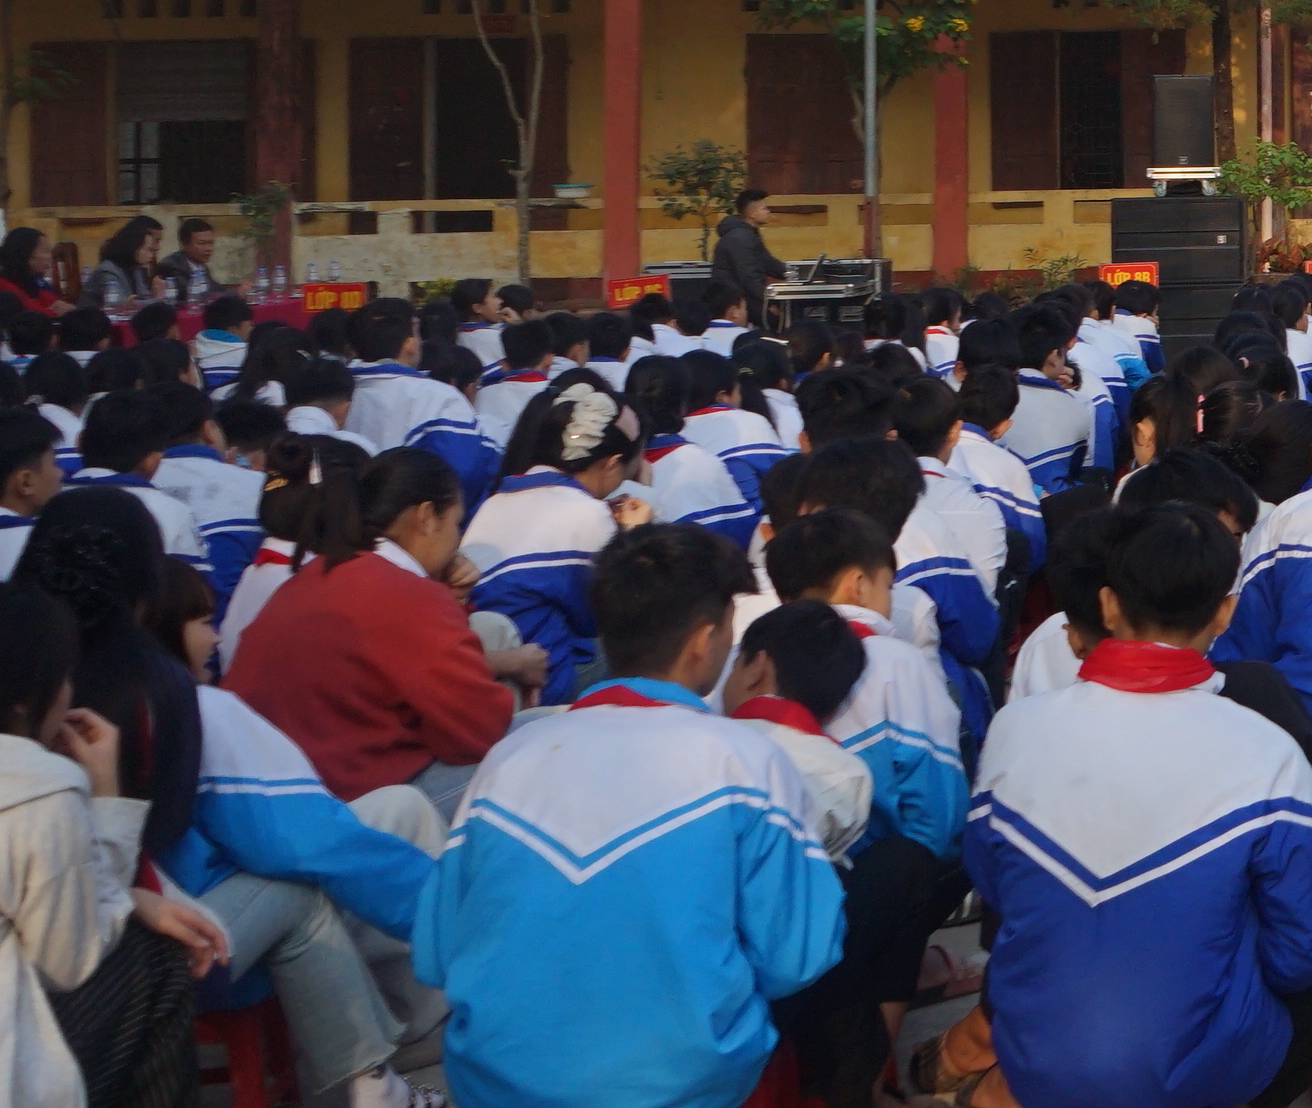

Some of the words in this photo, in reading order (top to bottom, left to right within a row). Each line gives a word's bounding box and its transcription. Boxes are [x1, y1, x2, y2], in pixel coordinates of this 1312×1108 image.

[1107, 268, 1131, 285] LỚP
[306, 287, 337, 310] LỚP
[614, 283, 641, 301] LỚP
